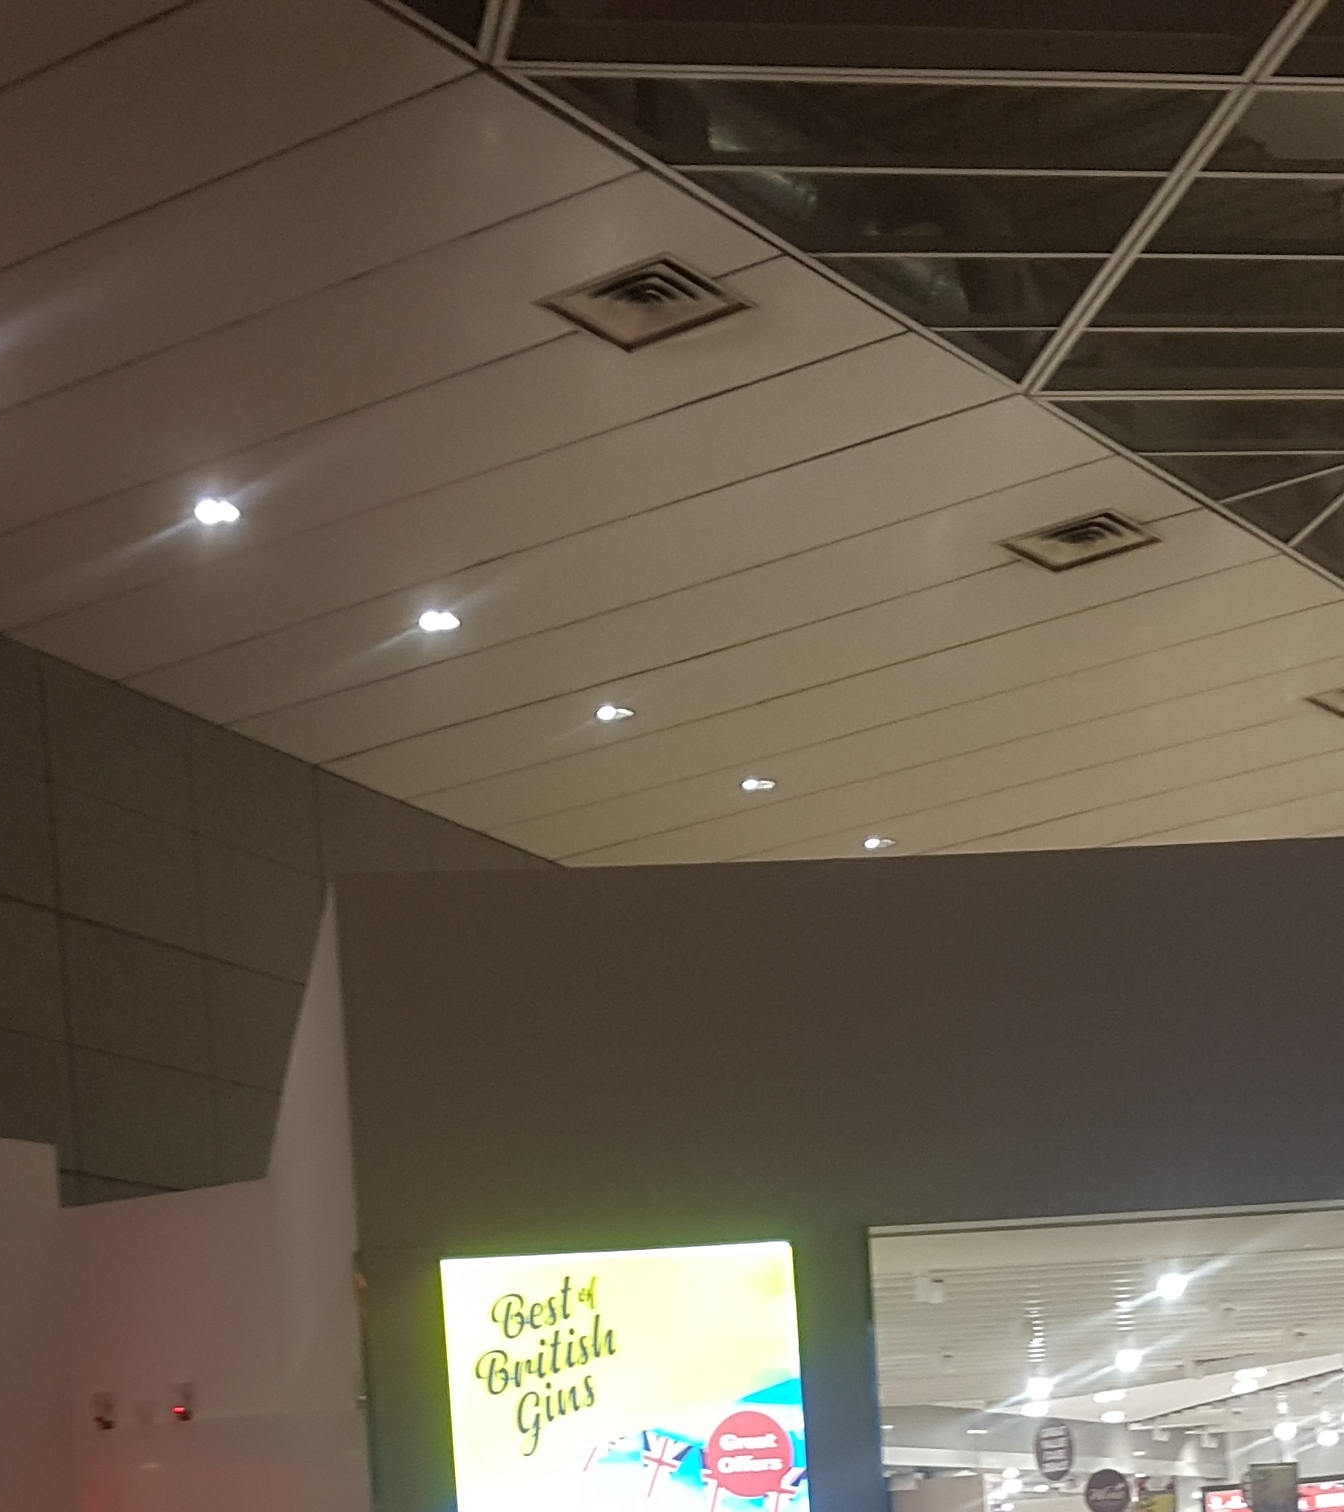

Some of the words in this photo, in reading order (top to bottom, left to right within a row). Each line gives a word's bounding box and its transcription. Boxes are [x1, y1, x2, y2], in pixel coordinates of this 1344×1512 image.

[491, 1276, 572, 1339] Best
[578, 1276, 597, 1310] of
[475, 1314, 616, 1395] British
[517, 1375, 596, 1457] Gins
[718, 1432, 779, 1451] Great
[717, 1454, 783, 1474] Offers
